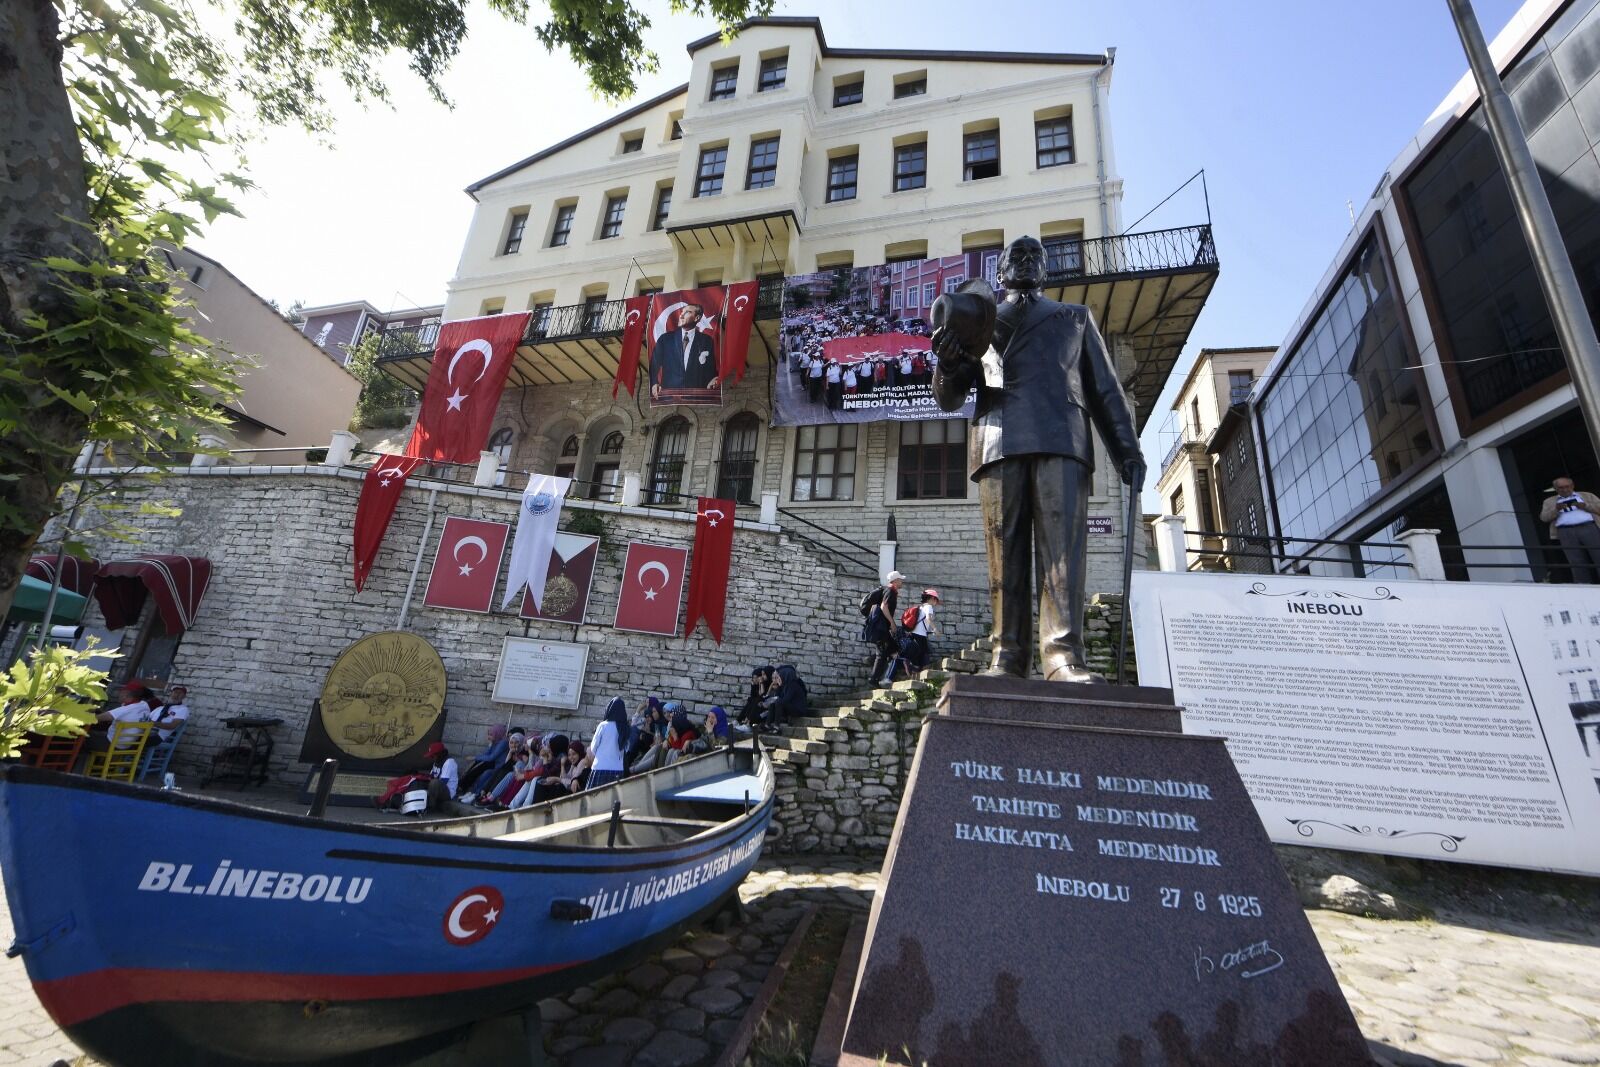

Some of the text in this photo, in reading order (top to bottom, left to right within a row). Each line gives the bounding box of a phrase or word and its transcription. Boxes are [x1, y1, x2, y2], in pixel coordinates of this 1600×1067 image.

[1287, 600, 1363, 616] İNEBOLU
[951, 760, 1212, 800] TÜRK HALKI MEDENİDİR
[972, 795, 1199, 832] TARİHTE MEDENİDİR
[955, 823, 1222, 867] HAKİKATTA MEDENİDİR
[138, 859, 373, 904] BL.İNEBOLU
[629, 866, 701, 910] MÜCADELE
[701, 847, 730, 884] ZAFERİ
[1036, 873, 1262, 917] İNEBOLU 27 8 1925
